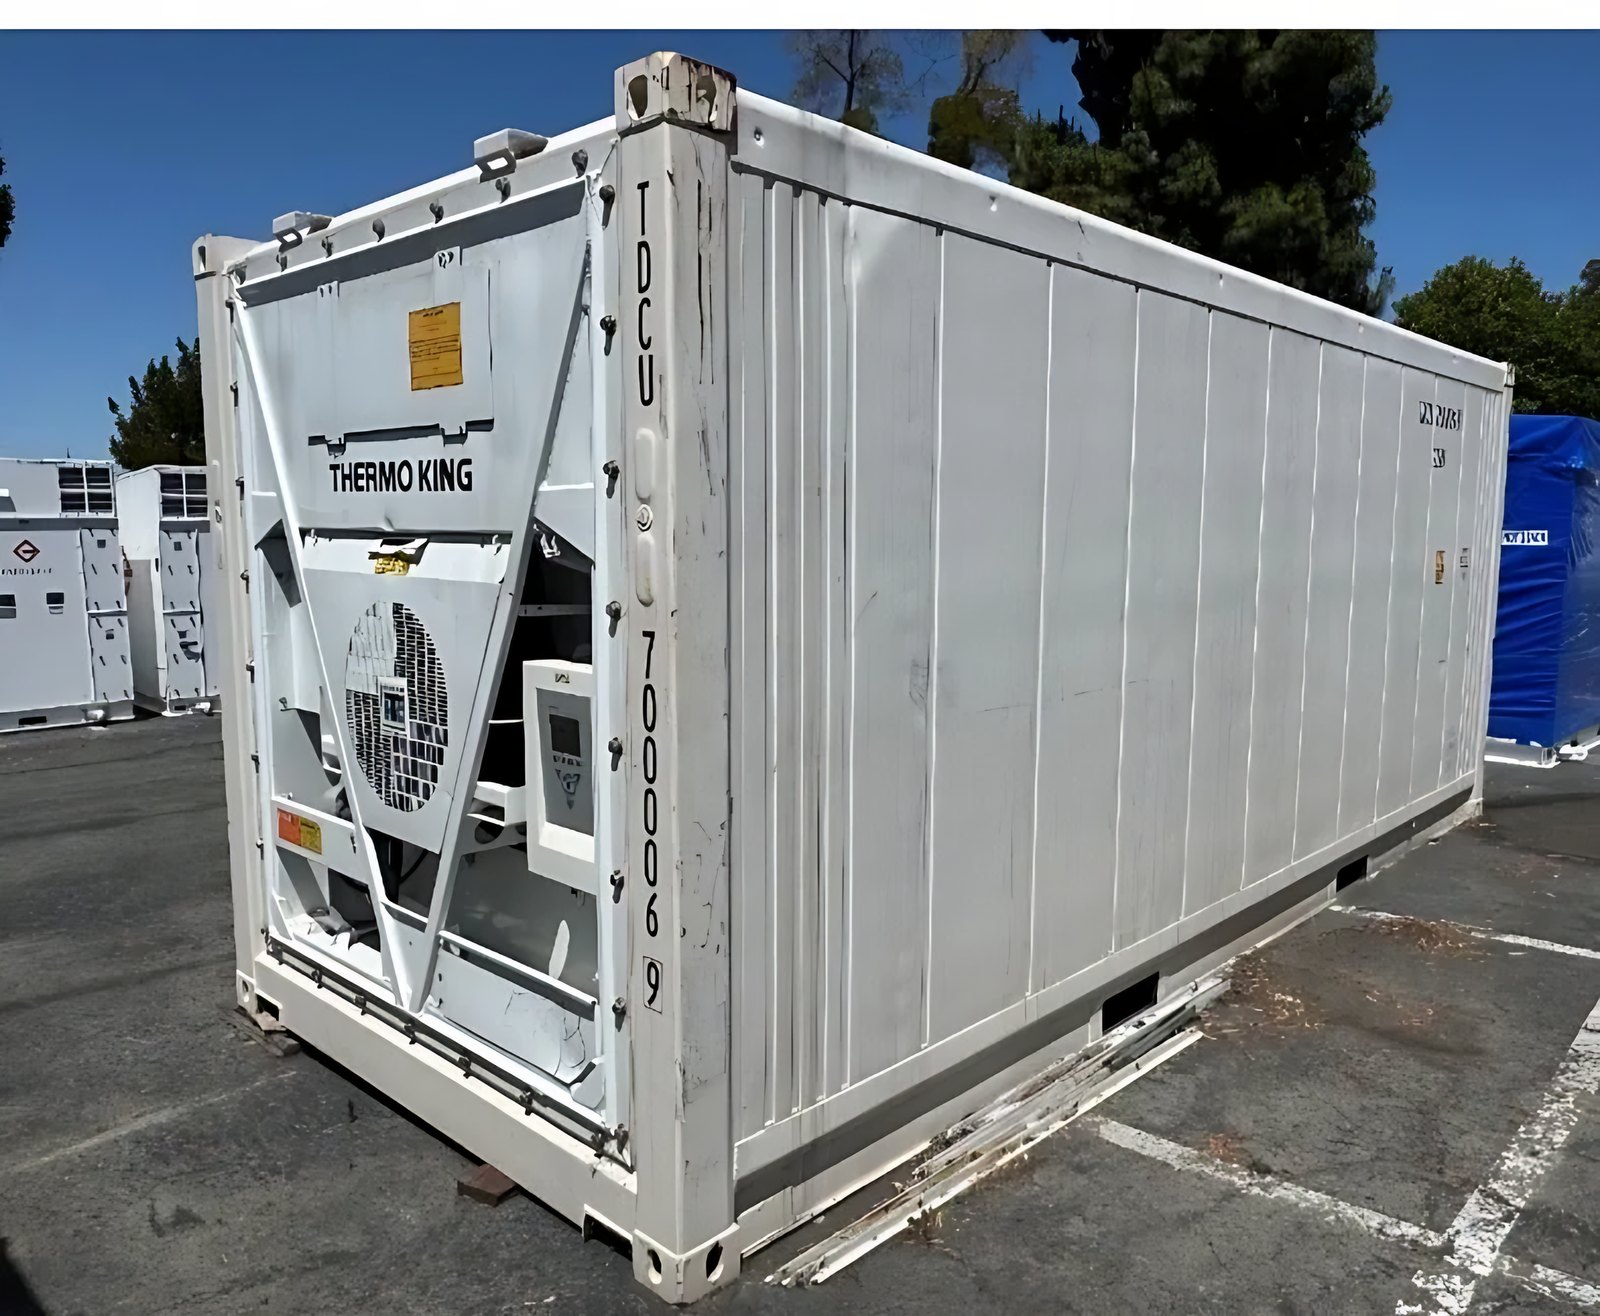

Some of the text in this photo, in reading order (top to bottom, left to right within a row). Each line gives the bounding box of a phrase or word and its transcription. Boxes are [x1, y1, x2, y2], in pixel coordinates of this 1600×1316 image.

[328, 457, 474, 493] THERMO KING
[637, 181, 660, 1007] TDCU 700006 9
